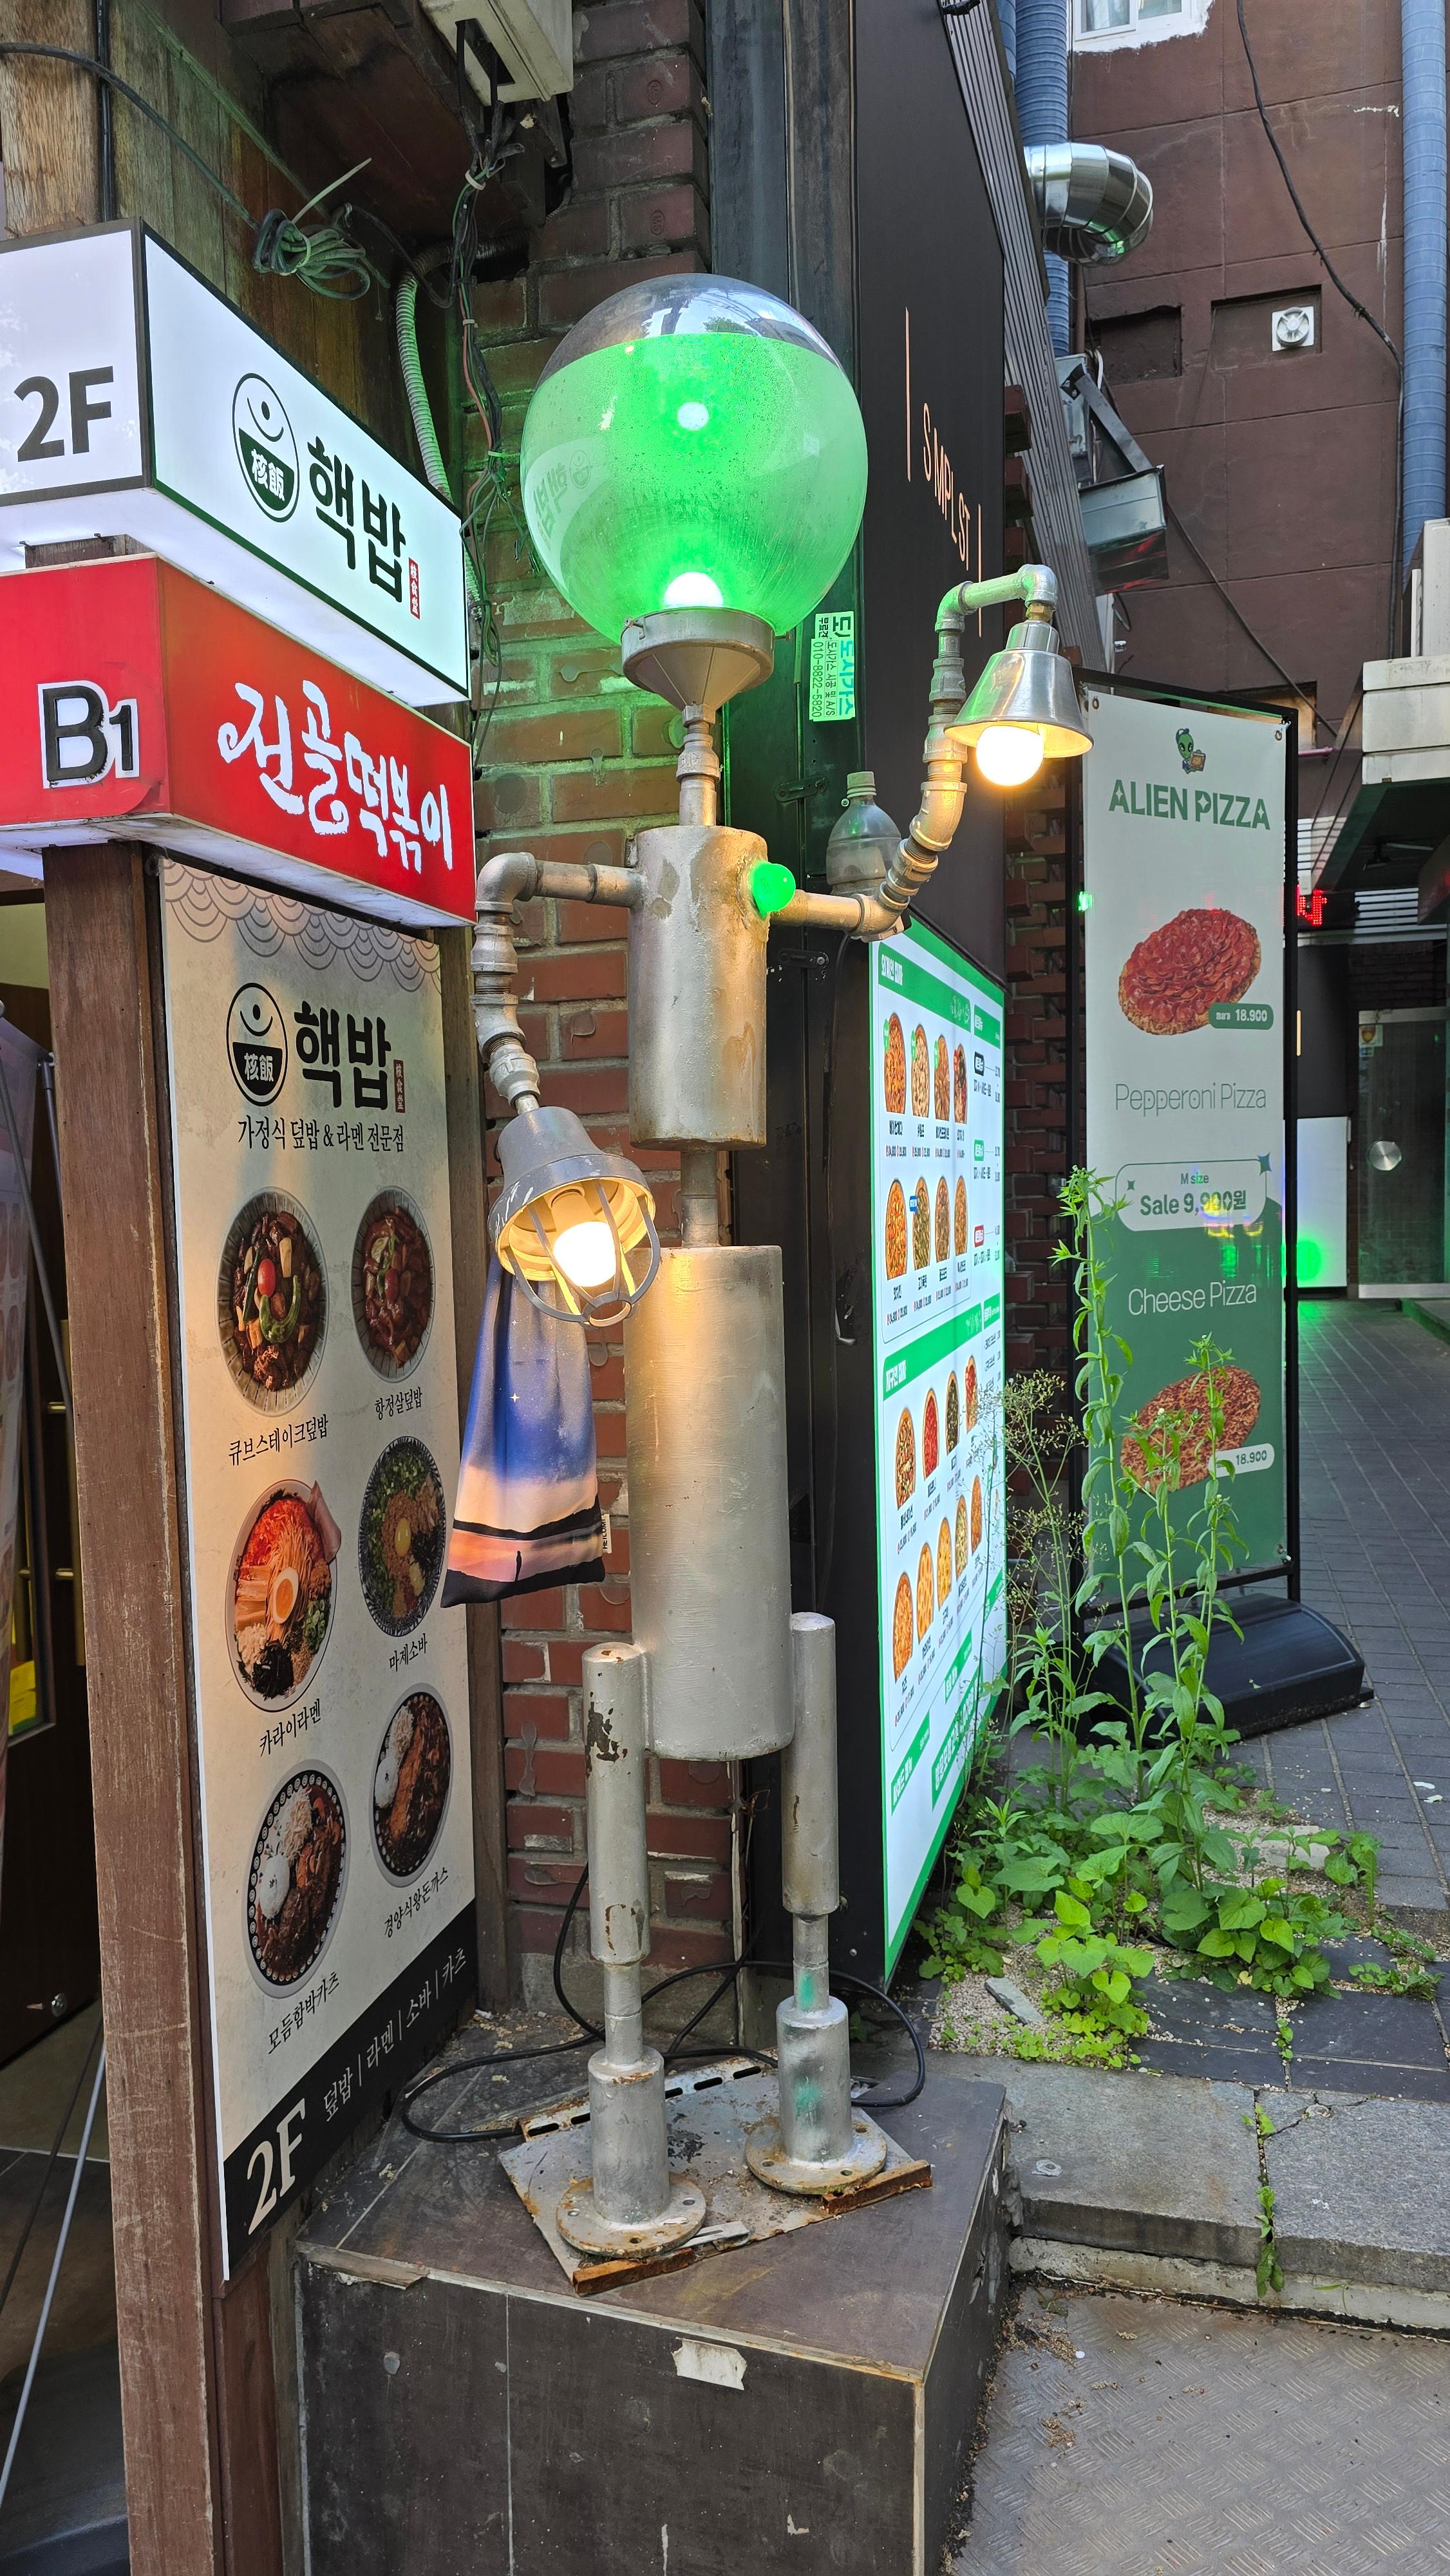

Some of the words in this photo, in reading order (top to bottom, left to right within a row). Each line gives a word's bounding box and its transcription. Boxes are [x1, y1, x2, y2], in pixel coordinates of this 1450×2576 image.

[14, 366, 114, 463] 2F
[308, 435, 406, 603] 핵밥
[826, 641, 837, 671] 도시가스
[812, 641, 824, 717] 010-8822-5820
[825, 674, 836, 688] 시공
[825, 701, 836, 716] A/S
[41, 683, 137, 786] B1
[1108, 779, 1188, 820] ALIEN
[1195, 790, 1270, 830] PIZZA
[1236, 1009, 1268, 1022] 18.900
[244, 1052, 274, 1082] 核飯
[294, 1000, 391, 1110] 핵밥
[1115, 1083, 1216, 1117] Pepperoni
[1221, 1082, 1266, 1110] Pizza
[238, 1115, 285, 1150] 가정식
[290, 1118, 320, 1151] 덮밥
[323, 1126, 335, 1147] &
[337, 1121, 364, 1151] 라멘
[368, 1123, 404, 1153] 전문점
[1180, 1173, 1189, 1184] M
[1191, 1171, 1209, 1184] size
[1140, 1194, 1180, 1216] Sale
[1128, 1288, 1205, 1316] Cheese
[1209, 1278, 1257, 1307] Pizza
[374, 1387, 423, 1421] 항정살덮밥
[228, 1414, 329, 1466] 큐브스테이크덮밥
[1236, 1450, 1267, 1466] 18.900
[389, 1633, 428, 1672] 마제소바
[259, 1698, 321, 1757] 카라이라멘
[384, 1866, 449, 1939] 경양식왕돈까스
[268, 1971, 339, 2054] 모듬함박카츠
[324, 2066, 353, 2122] 덮밥
[366, 2019, 395, 2069] 라멘
[406, 1980, 432, 2029] 소바
[442, 1947, 467, 1988] 카츠
[247, 2098, 306, 2236] 2F
